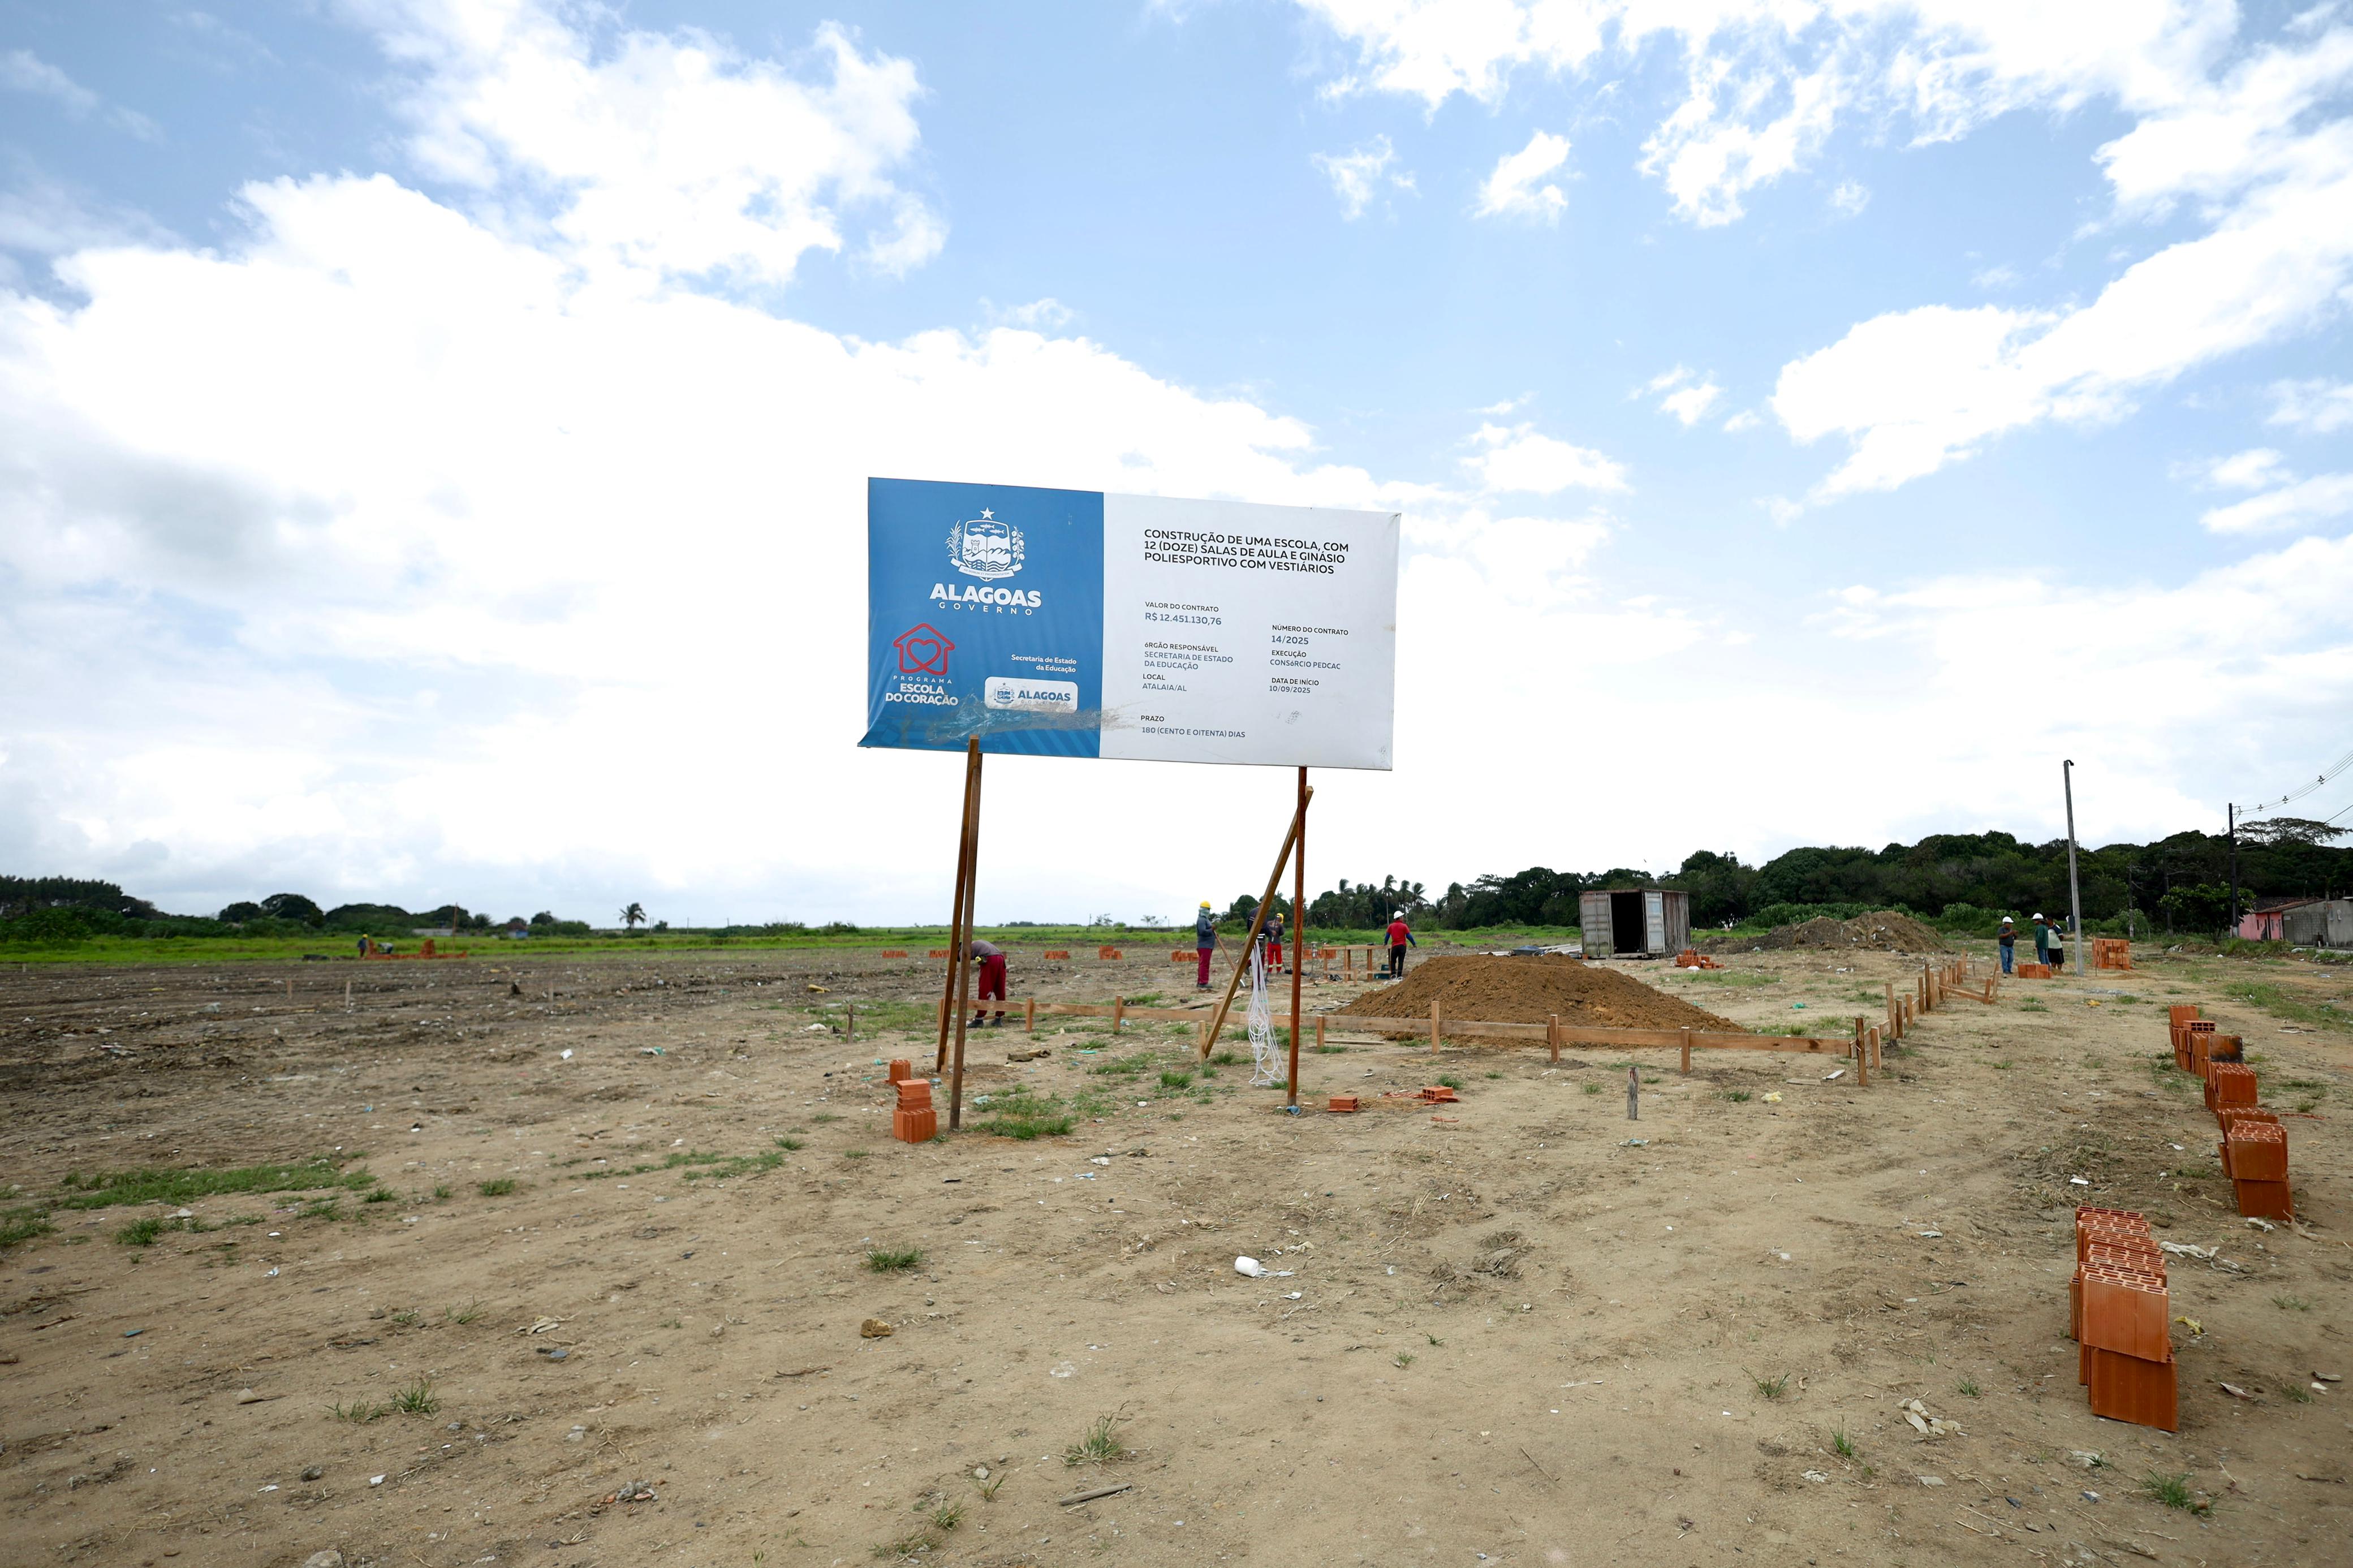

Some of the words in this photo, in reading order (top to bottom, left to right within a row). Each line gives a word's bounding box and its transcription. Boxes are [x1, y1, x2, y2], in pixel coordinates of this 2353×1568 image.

[1144, 529, 1225, 544] CONSTRUÇÃO
[1228, 535, 1243, 544] DE
[1246, 536, 1272, 546] UMA
[1274, 539, 1321, 552] ESCOLA,
[1324, 542, 1348, 552] COM
[1144, 541, 1156, 549] 12
[1159, 540, 1197, 554] (DOZE)
[1201, 545, 1237, 555] SALAS
[1240, 548, 1255, 557] DE
[1257, 549, 1288, 559] AULA
[1291, 551, 1297, 559] E
[1299, 551, 1344, 563] GINÁSIO
[1144, 552, 1237, 567] POLIESPORTIVO
[1240, 559, 1266, 569] COM
[1269, 561, 1334, 574] VESTIÁRIOS
[929, 583, 1041, 608] ALAGOAS
[939, 602, 1032, 615] GOVERNO
[1145, 612, 1157, 622] R$
[1160, 614, 1222, 626] 12.451.130,76
[1272, 623, 1301, 632] NÚMERO
[1272, 635, 1309, 645] 14/2025
[1170, 644, 1218, 652] RESPONSÁVEL
[1011, 654, 1044, 662] Secretaria
[1144, 651, 1191, 660] SECRETARIA
[1272, 650, 1307, 658] EXECUÇÃO
[1045, 665, 1076, 674] Educação
[1157, 661, 1199, 670] EDUCAÇÃO
[893, 675, 952, 684] PROGRAMA
[900, 683, 945, 695] ESCOLA
[1142, 683, 1187, 691] ATALAIA/AL
[1269, 685, 1311, 693] 10/09/2025
[885, 692, 903, 702] DO
[903, 693, 959, 706] CORAÇÃO
[1018, 690, 1071, 701] ALAGOAS
[1192, 729, 1227, 738] OITENTA)
